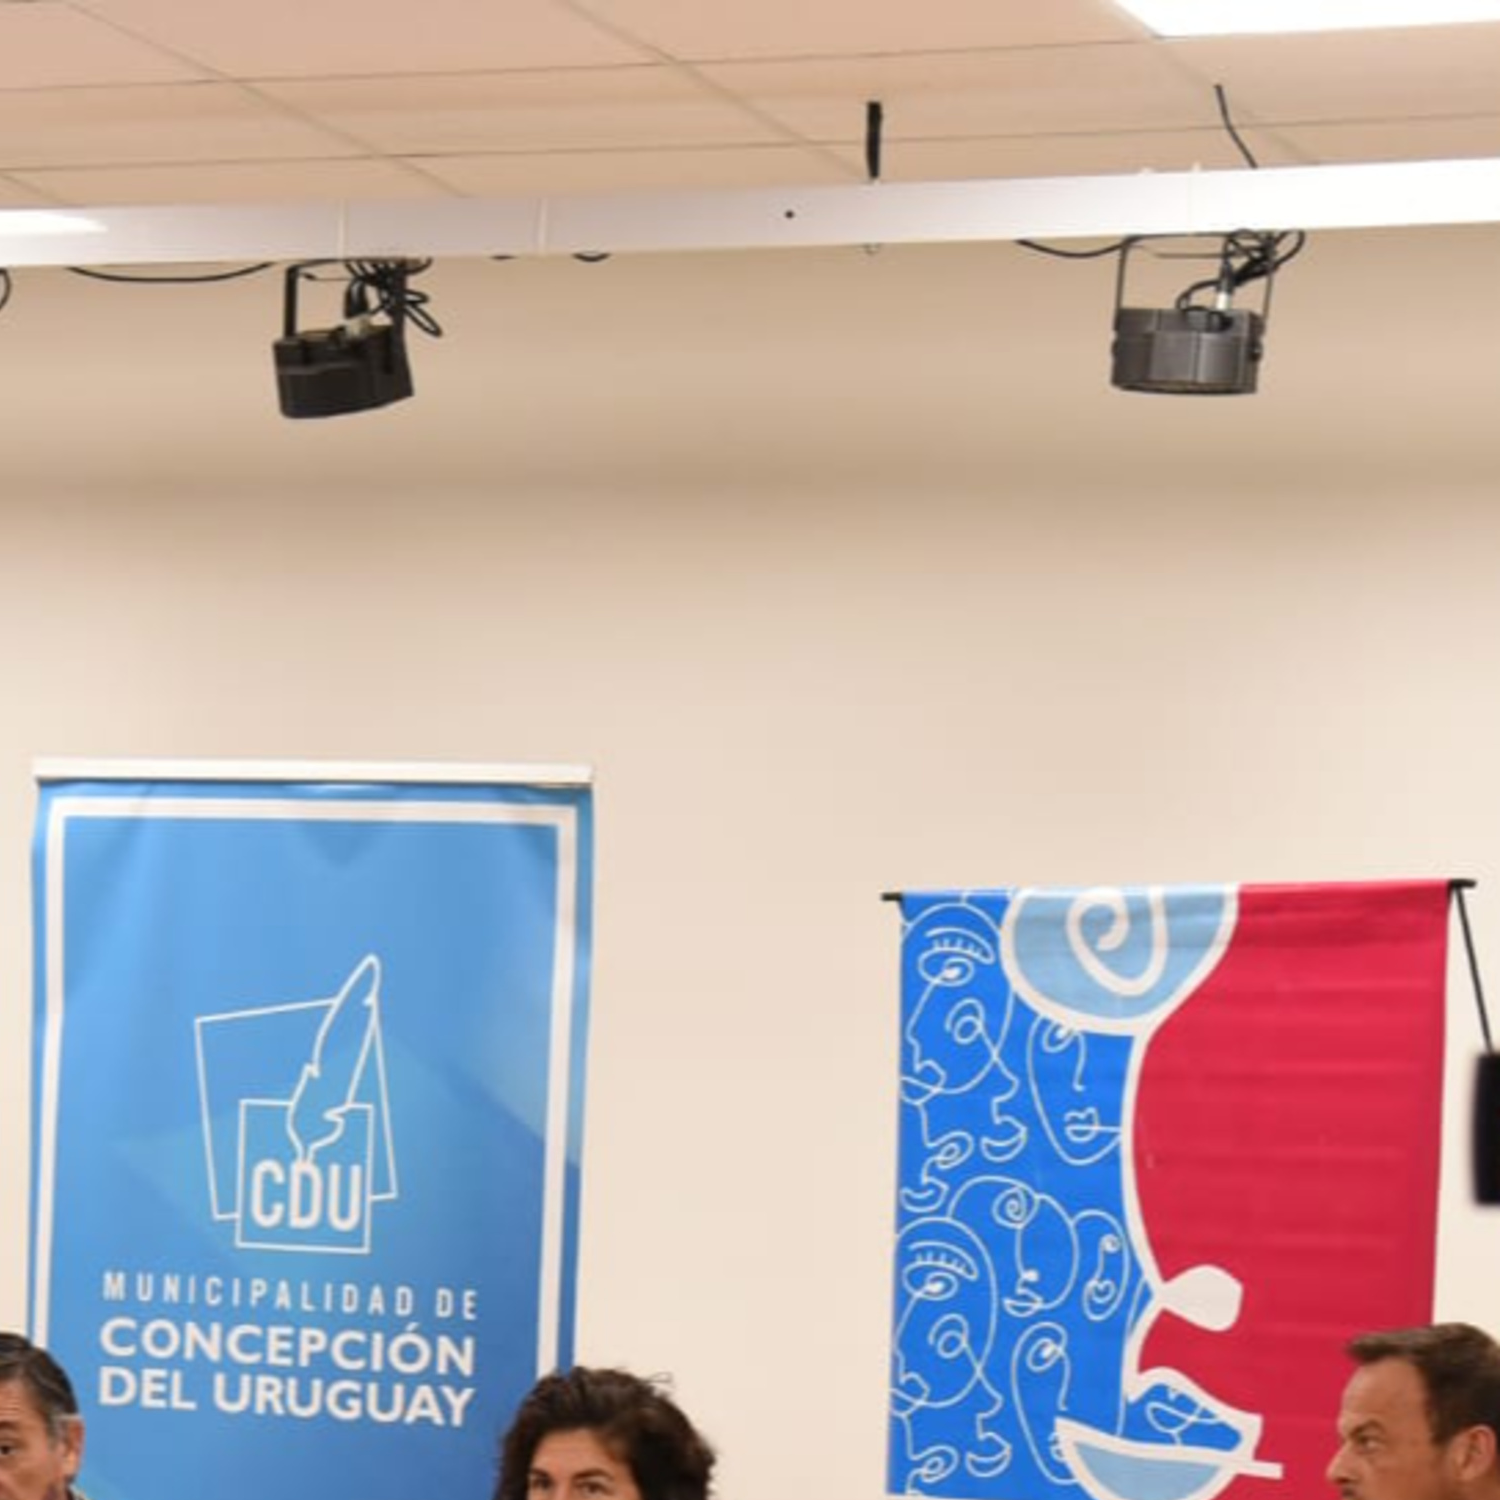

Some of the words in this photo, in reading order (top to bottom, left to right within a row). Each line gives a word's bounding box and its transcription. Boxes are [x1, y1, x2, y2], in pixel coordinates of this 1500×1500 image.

[251, 1160, 363, 1231] CDU
[102, 1271, 414, 1317] MUNICIPALIDAD
[436, 1290, 478, 1320] DE
[99, 1317, 476, 1377] CONCEPCIÓN
[98, 1366, 197, 1411] DEL
[214, 1373, 477, 1428] URUGUAY
